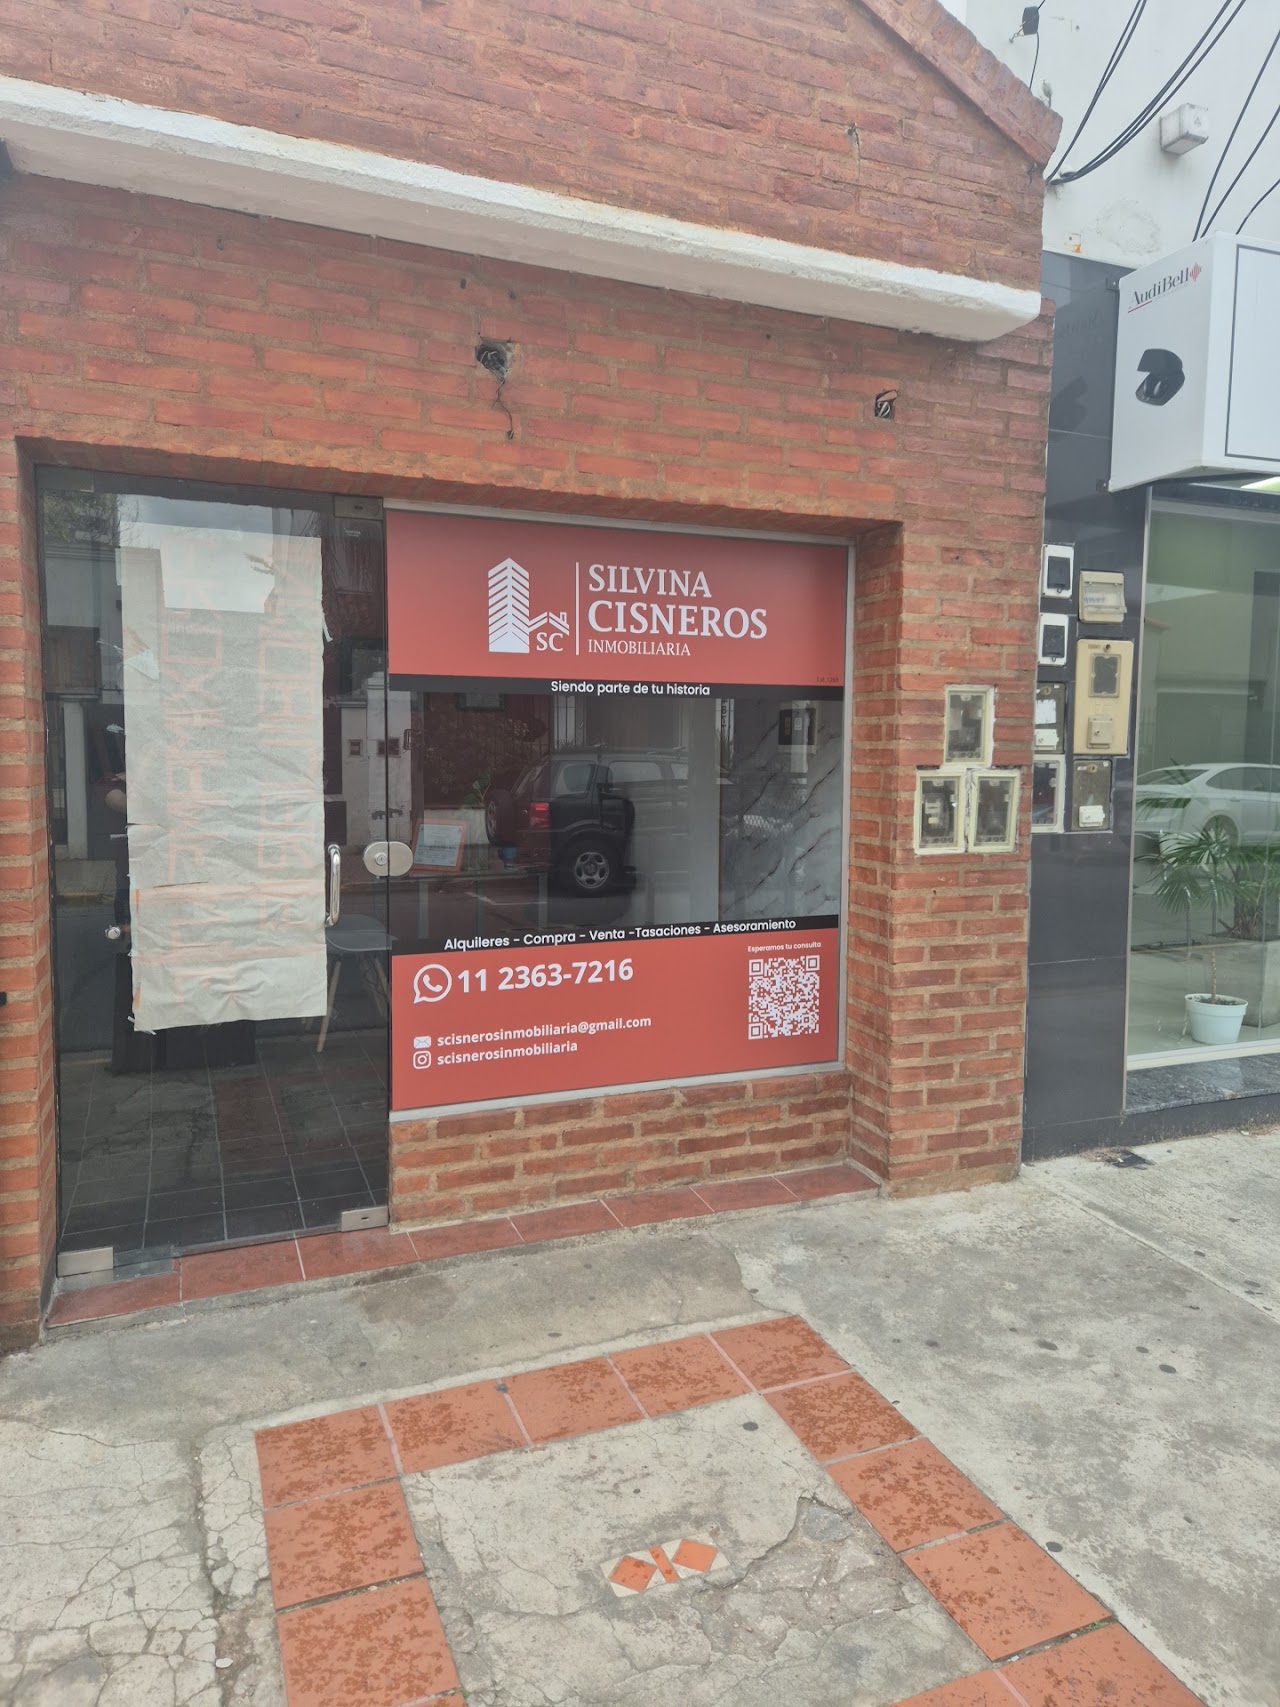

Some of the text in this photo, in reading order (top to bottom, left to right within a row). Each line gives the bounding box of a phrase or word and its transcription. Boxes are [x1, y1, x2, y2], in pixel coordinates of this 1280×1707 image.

[1128, 267, 1189, 309] AudiBell
[588, 563, 712, 598] SILVINA
[588, 600, 768, 640] CISNEROS
[536, 632, 564, 652] SC
[588, 639, 691, 656] INMOBILIARIA
[551, 681, 710, 696] Siendo parte de tu historia
[444, 936, 510, 952] Alquileres
[523, 932, 576, 946] Compra
[589, 929, 625, 941] Venta
[713, 919, 796, 934] Asesoramiento
[748, 941, 822, 953] Esperamos tu consulta
[458, 958, 634, 993] 11 2363-7216
[437, 1017, 652, 1047] scisnerosinmobiliaria@gmail.com
[437, 1041, 578, 1065] scisnerosinmobiliaria
